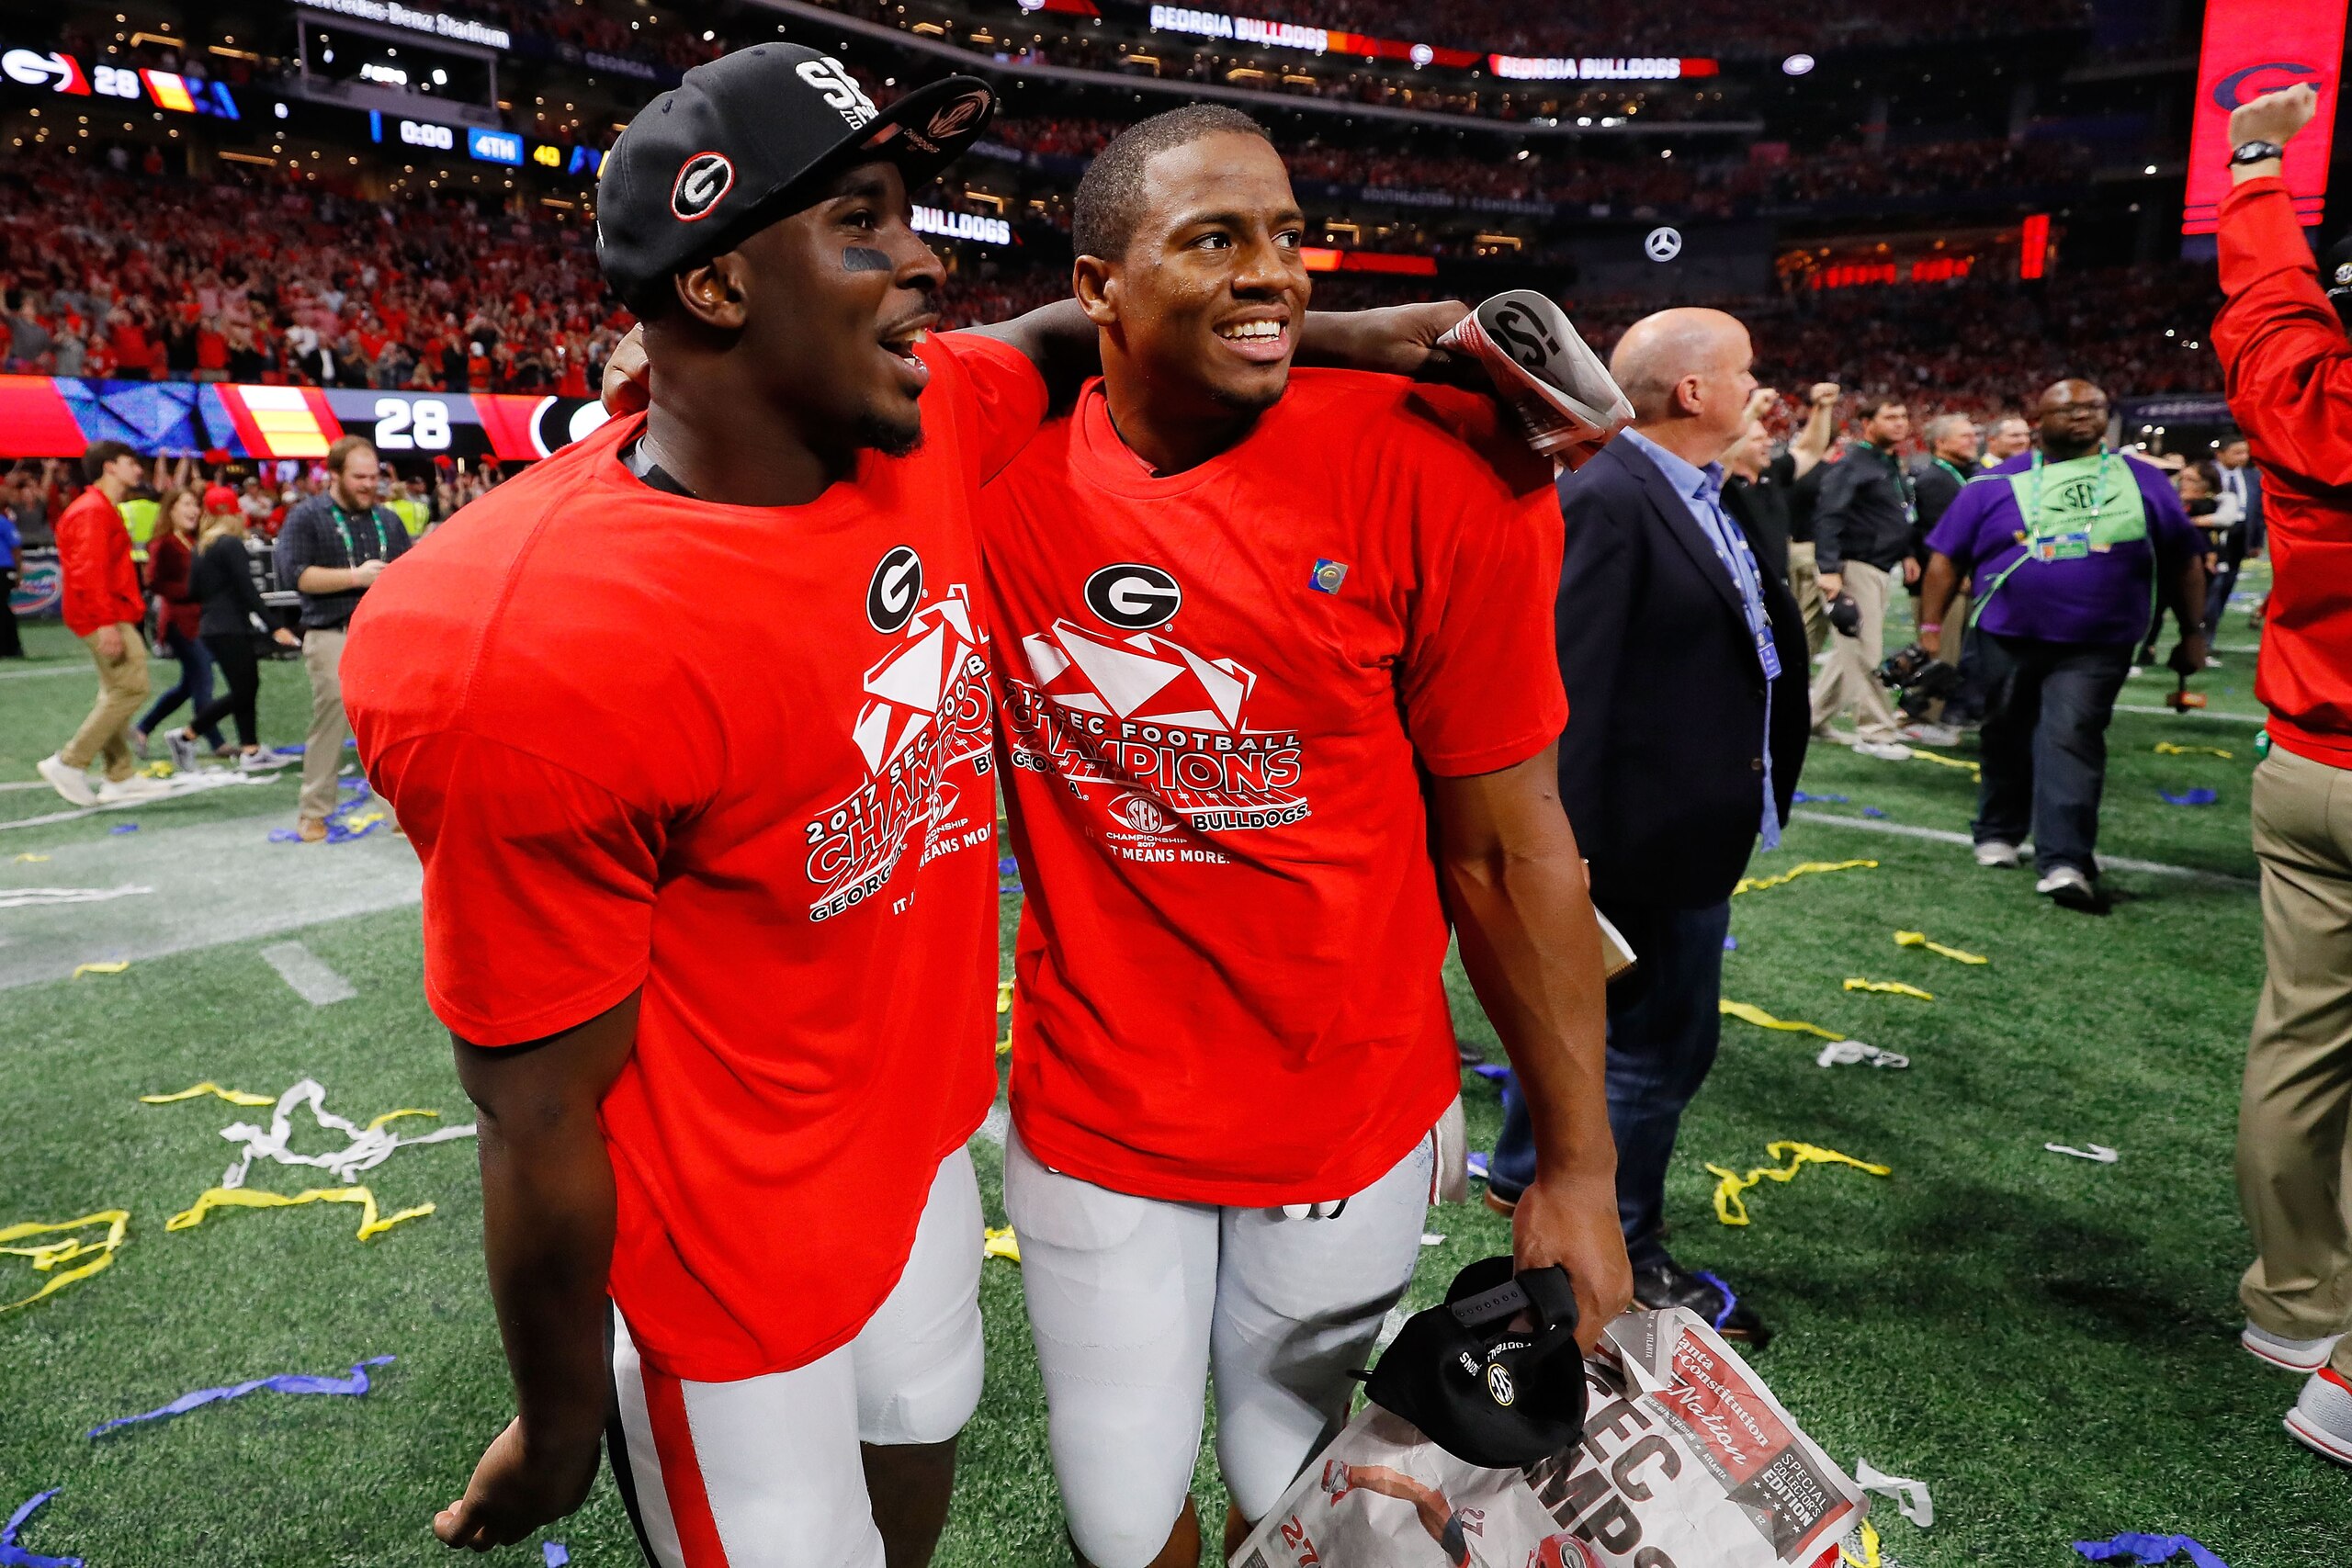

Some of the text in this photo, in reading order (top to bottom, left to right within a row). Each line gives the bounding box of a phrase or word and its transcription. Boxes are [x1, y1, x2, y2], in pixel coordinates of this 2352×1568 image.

[436, 13, 510, 49] Stadium
[1150, 5, 1328, 51] GEORGIA BULLDOGS
[94, 65, 140, 99] 28
[1498, 55, 1680, 80] GEORGIA BULLDOGS
[401, 120, 560, 168] 0:00 4TH 40
[672, 152, 734, 220] G
[910, 204, 1011, 245] BULLDOGS
[375, 397, 452, 449] 28
[866, 545, 924, 635] G
[1083, 562, 1182, 630] G
[1056, 706, 1105, 735] SEC
[1121, 722, 1301, 751] FOOTBALL
[805, 784, 877, 844] 2017
[889, 731, 928, 784] SEC
[1105, 831, 1188, 844] CHAMPIONSHIP
[1127, 800, 1159, 832] SEC
[1192, 803, 1309, 832] BULLDOGS
[1122, 847, 1175, 863] MEANS
[1180, 849, 1231, 864] MORE.
[892, 897, 907, 915] IT
[1645, 1333, 1654, 1359] ATLANTA
[1489, 1366, 1513, 1404] SEC
[1667, 1385, 1747, 1466] Nation
[1669, 1416, 1698, 1441] STADIUM
[1702, 1452, 1727, 1480] ATLANTA
[1761, 1468, 1815, 1528] EDITION
[1772, 1461, 1821, 1517] COLLECTOR'S
[1781, 1453, 1828, 1511] SPECIAL
[1280, 1514, 1319, 1568] 27
[1459, 1506, 1486, 1538] 27
[1754, 1514, 1767, 1526] $2
